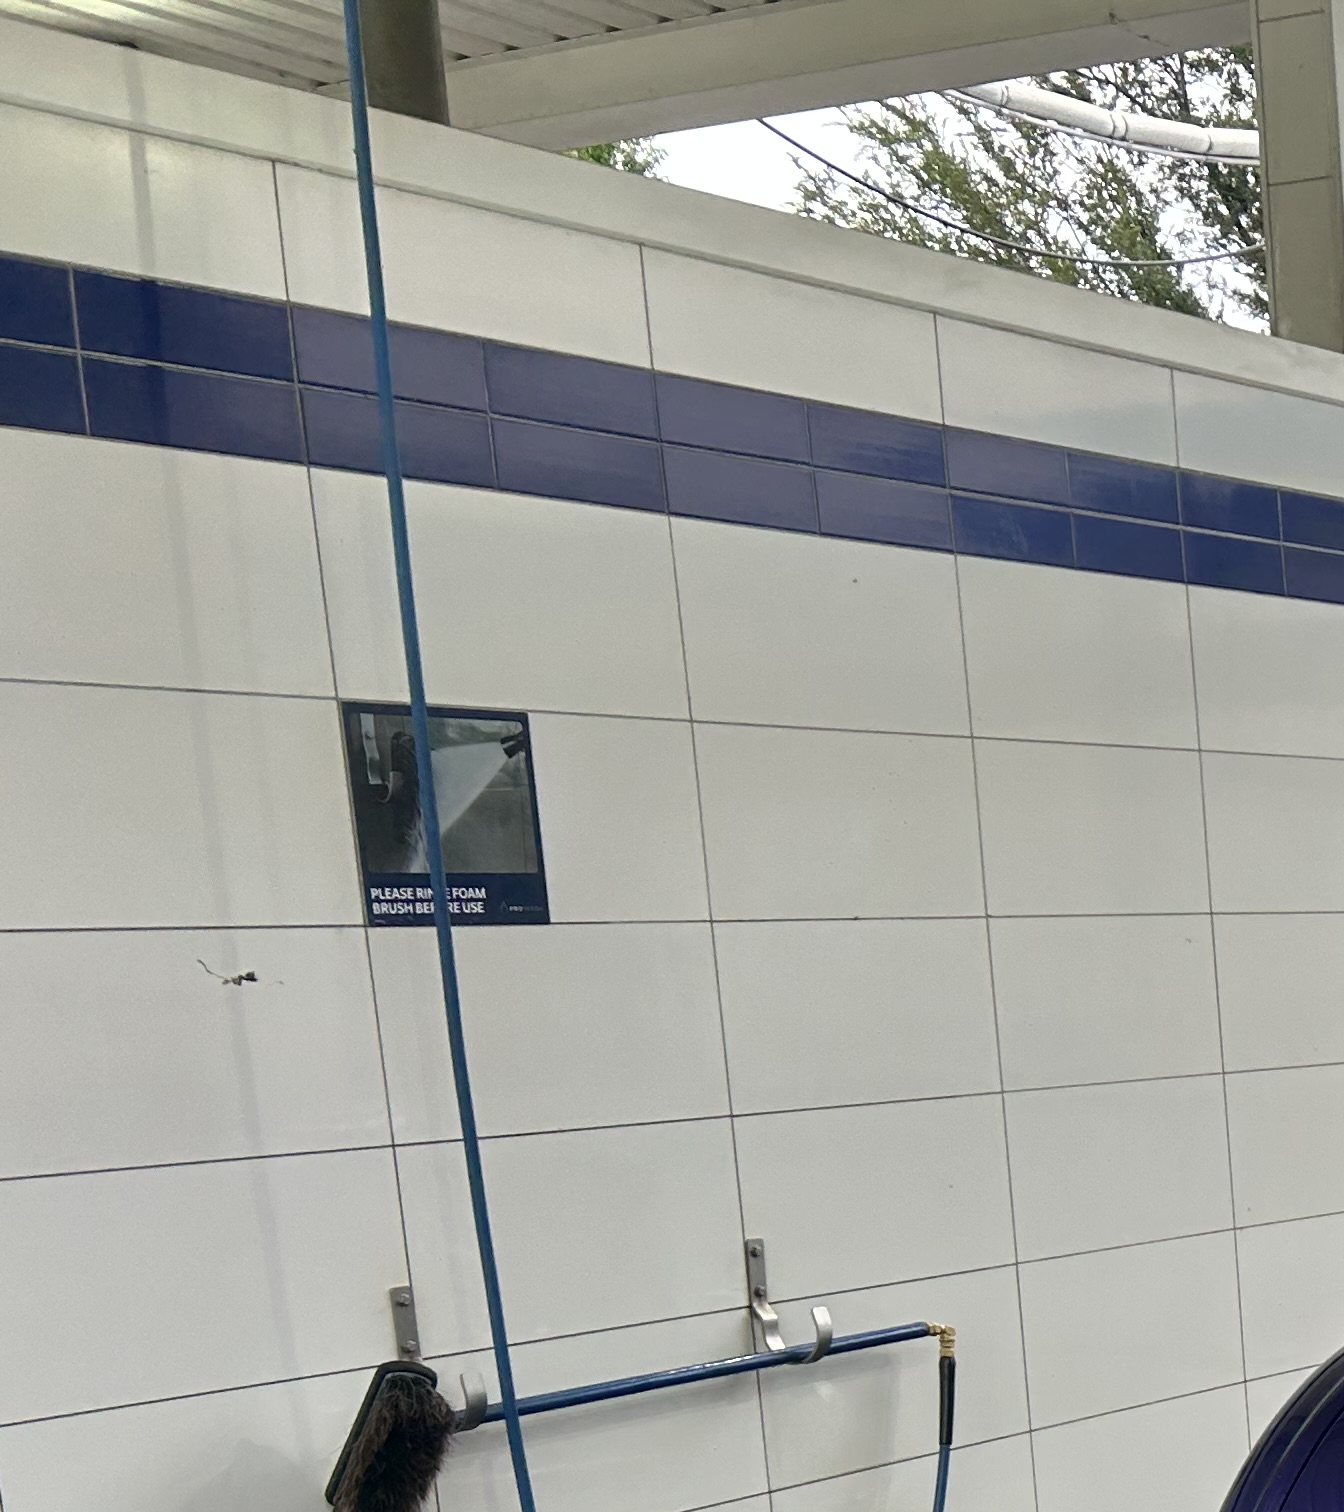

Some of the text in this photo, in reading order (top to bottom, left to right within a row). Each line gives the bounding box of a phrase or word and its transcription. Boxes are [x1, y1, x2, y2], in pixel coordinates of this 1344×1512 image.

[370, 887, 487, 900] PLEASE RINE FOAM
[372, 901, 486, 915] BRUSH BERE USE
